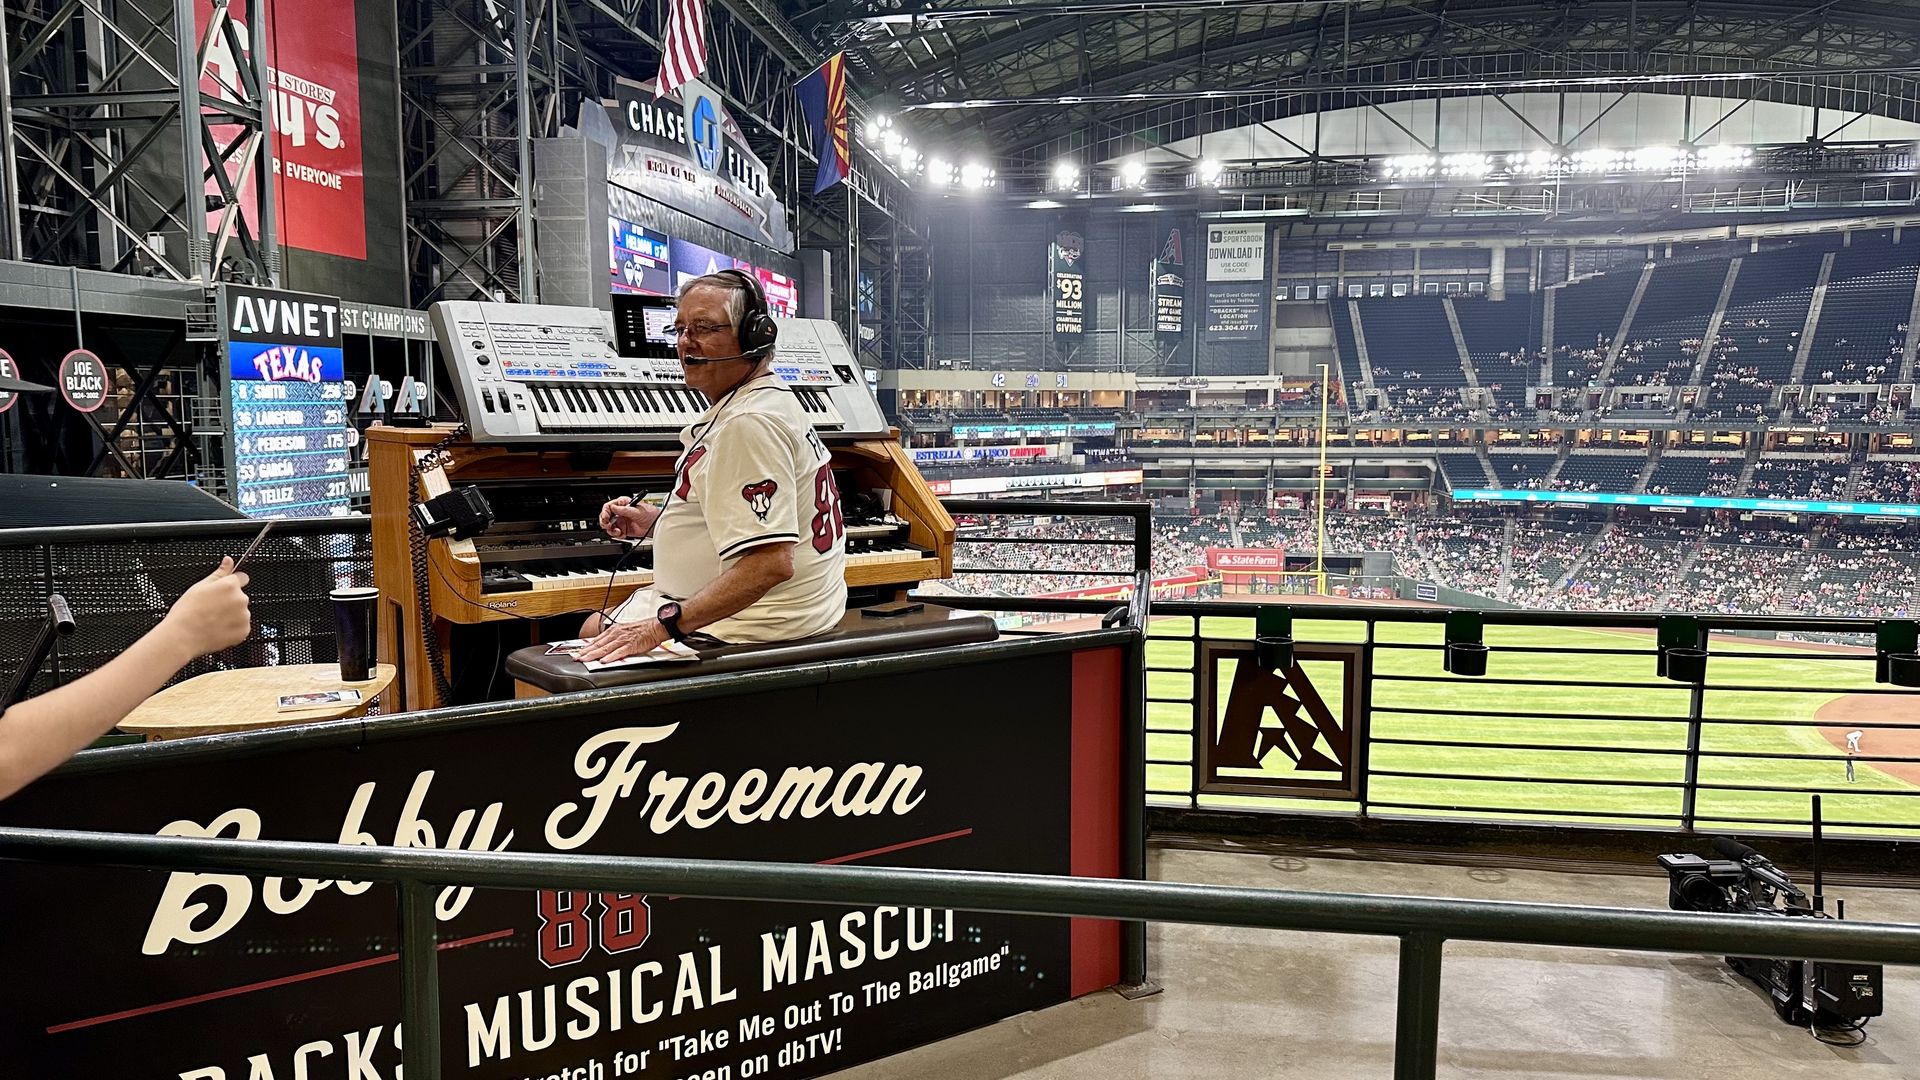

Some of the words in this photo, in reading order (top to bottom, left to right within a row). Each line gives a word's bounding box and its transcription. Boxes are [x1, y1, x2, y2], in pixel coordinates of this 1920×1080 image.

[284, 76, 331, 103] STORES
[628, 100, 686, 145] CHASE
[728, 146, 767, 199] FIELD
[286, 162, 342, 190] EVERYONE
[1223, 235, 1263, 243] SPORTSBOOK
[1209, 247, 1252, 260] DOWNLOAD
[1255, 247, 1263, 259] IT
[1056, 279, 1083, 300] $93
[1056, 300, 1083, 310] MILLION
[1157, 298, 1182, 308] STREAM
[232, 295, 337, 339] AVNET
[362, 310, 425, 334] CHAMPIONS
[1056, 323, 1082, 334] GIVING
[73, 361, 94, 376] JOE
[252, 345, 323, 383] TEXAS
[66, 376, 102, 390] BLACK
[992, 373, 1005, 387] 42
[1025, 373, 1040, 388] 20
[1056, 373, 1068, 388] 51
[323, 433, 344, 448] .175
[915, 450, 962, 460] ESTRELLA
[973, 448, 1008, 459] JALISCO
[239, 464, 255, 480] 53
[259, 486, 294, 504] TELLEZ
[489, 600, 518, 609] Roland
[544, 720, 927, 850] Freeman
[464, 945, 738, 1068] MUSICAL
[613, 1049, 651, 1077] for
[658, 1029, 730, 1062] "Take
[739, 1015, 775, 1043] Me
[784, 998, 822, 1029] Out
[829, 992, 855, 1017] To
[862, 975, 901, 1009] The
[907, 944, 1010, 996] Ballgame"
[740, 1053, 768, 1076] on
[777, 1027, 842, 1068] dbTV!
